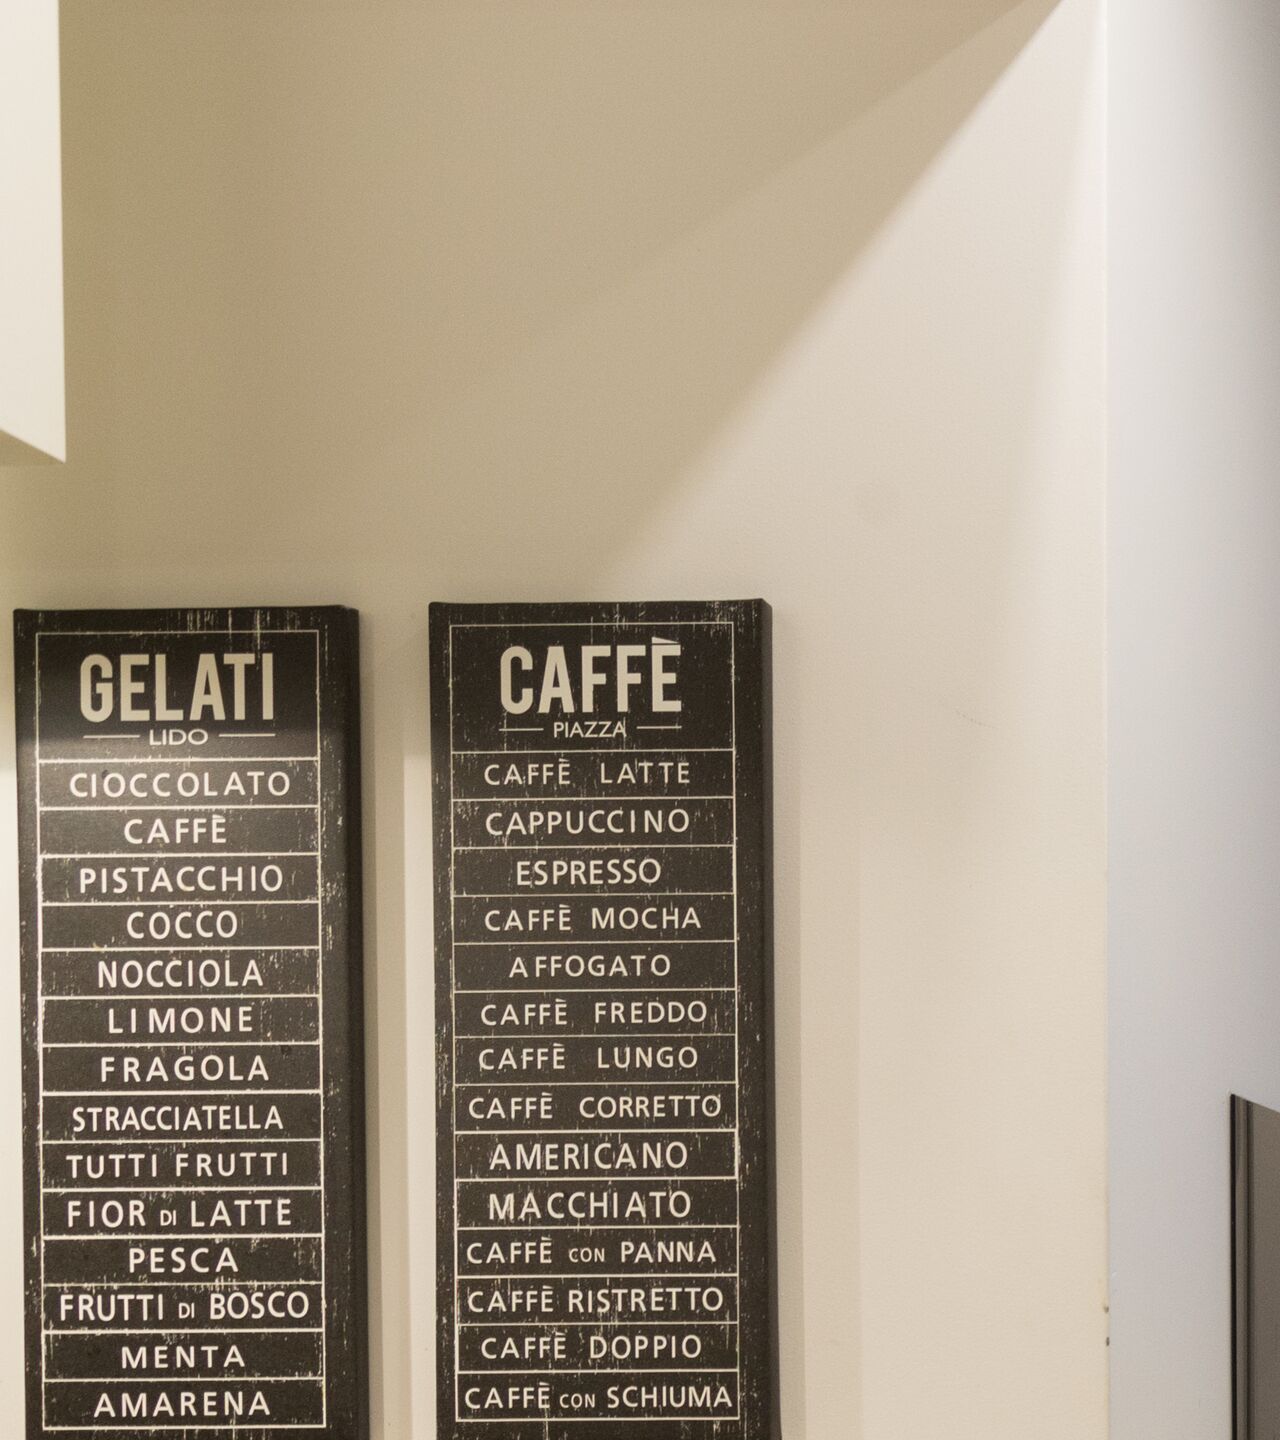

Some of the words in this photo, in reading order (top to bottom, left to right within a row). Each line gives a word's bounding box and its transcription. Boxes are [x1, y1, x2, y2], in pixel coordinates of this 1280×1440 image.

[80, 652, 274, 722] GELATI
[499, 636, 682, 715] CAFFÈ
[149, 729, 208, 746] LIDO
[553, 721, 627, 738] PIAZZA
[69, 771, 291, 798] CIOCCOLATO
[484, 757, 571, 786] CAFFÈ
[600, 762, 691, 784] LATTE
[124, 814, 227, 844] CAFFÈ
[485, 808, 690, 836] CAPPUCCINO
[79, 865, 283, 893] PISTACCHIO
[516, 858, 661, 886] ESPRESSO
[126, 910, 238, 939] COCCO
[484, 903, 572, 931] CAFFÈ
[591, 906, 702, 931] MOCHA
[98, 959, 264, 988] NOCCIOLA
[508, 953, 671, 978] AFFOGATO
[108, 1006, 254, 1034] LIMONE
[480, 998, 568, 1026] CAFFÈ
[594, 1000, 708, 1025] FREDDO
[100, 1055, 270, 1082] FRAGOLA
[478, 1043, 566, 1071] CAFFÈ
[598, 1046, 699, 1069] LUNGO
[72, 1105, 284, 1132] STRACCIATELLA
[468, 1092, 553, 1119] CAFFÈ
[578, 1094, 722, 1119] CORRETTO
[66, 1153, 157, 1178] TUTTI
[175, 1152, 288, 1177] FRUTTI
[489, 1140, 688, 1171] AMERICANO
[67, 1200, 146, 1228] FIOR
[160, 1209, 177, 1226] DI
[191, 1198, 292, 1228] LATTE
[488, 1191, 692, 1221] MACCHIATO
[128, 1247, 239, 1273] PESCA
[466, 1236, 553, 1264] CAFFÈ
[568, 1247, 605, 1263] CON
[620, 1240, 717, 1264] PANNA
[60, 1294, 164, 1321] FRUTTI
[178, 1303, 195, 1319] DI
[209, 1291, 310, 1320] BOSCO
[467, 1285, 554, 1312] CAFFÈ
[568, 1287, 724, 1313] RISTRETTO
[121, 1345, 246, 1369] MENTA
[480, 1333, 567, 1360] CAFFÈ
[589, 1334, 702, 1360] DOPPIO
[93, 1391, 271, 1418] AMARENA
[464, 1381, 550, 1409] CAFFÈ
[559, 1393, 596, 1409] CON
[606, 1385, 733, 1409] SCHIUMA
